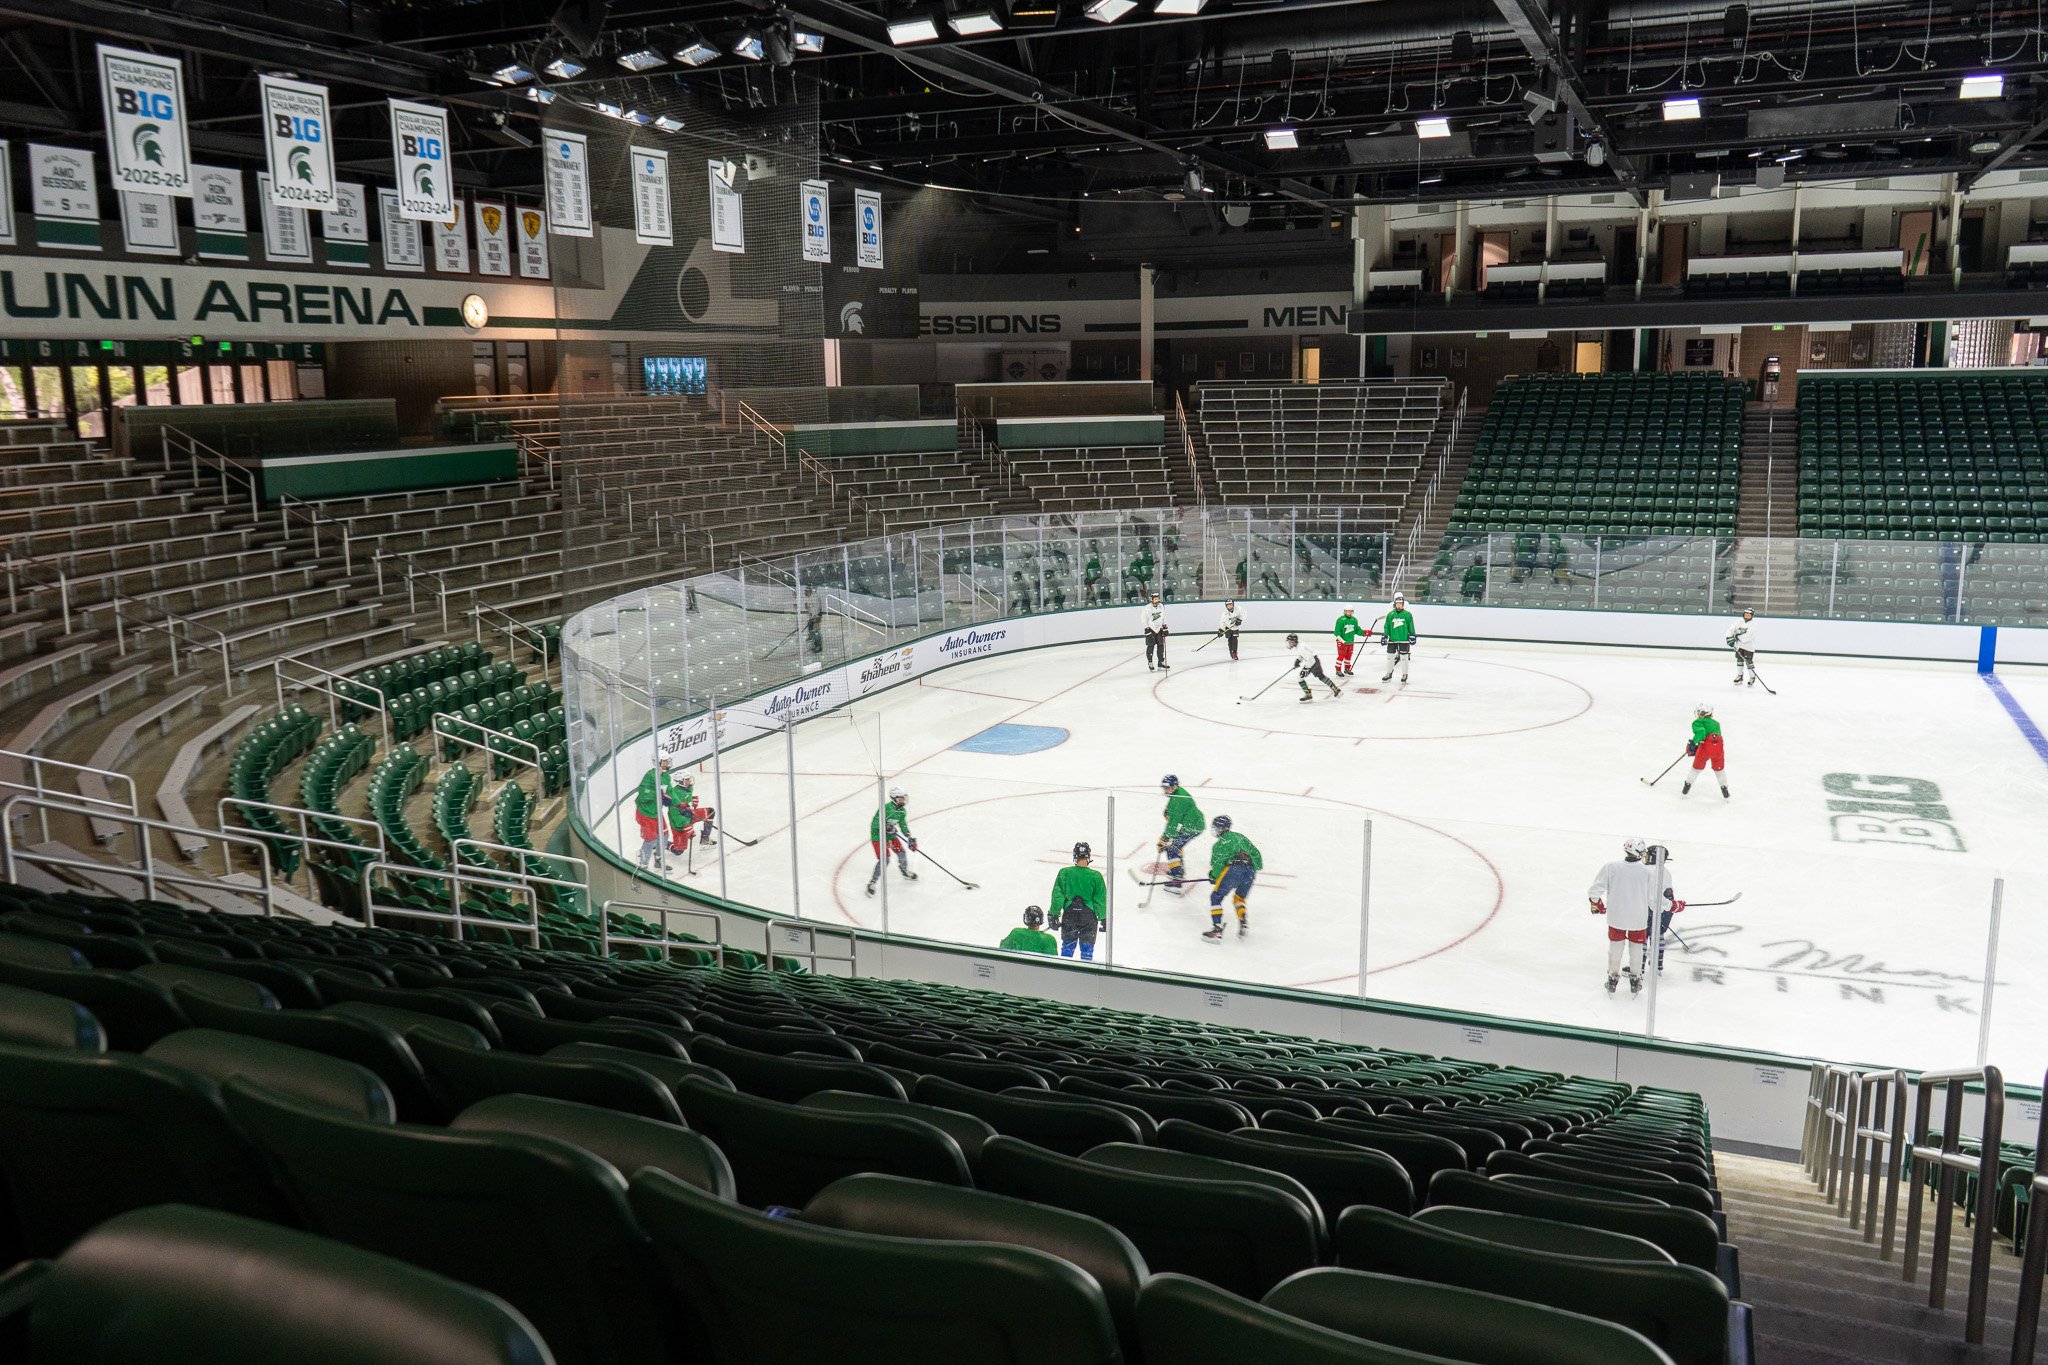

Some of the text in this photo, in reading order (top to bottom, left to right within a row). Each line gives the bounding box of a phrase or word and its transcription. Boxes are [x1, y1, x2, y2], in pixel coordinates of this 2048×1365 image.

[112, 71, 173, 91] CHAMPIONS
[271, 100, 320, 116] CHAMPIONS
[400, 121, 441, 136] CHAMPIONS
[53, 166, 75, 179] AMO
[551, 158, 581, 171] TOURNAMENT
[42, 176, 88, 192] BESSONE
[122, 167, 182, 188] 2025-26
[638, 173, 664, 185] TOURNAMENT
[208, 183, 226, 195] RON
[280, 185, 330, 204] 2024-25
[204, 193, 233, 206] MASON
[406, 199, 448, 215] 2023-24
[809, 247, 824, 257] 2024
[864, 254, 876, 264] 2025
[0, 270, 420, 326] UNN ARENA
[901, 287, 918, 295] PLAYER
[1263, 304, 1346, 328] MEN
[939, 628, 1007, 653] Auto-Owners
[951, 643, 992, 660] INSURANCE
[860, 661, 901, 684] Shaheen
[764, 682, 832, 716] Auto-Owners
[657, 731, 707, 755] haheen
